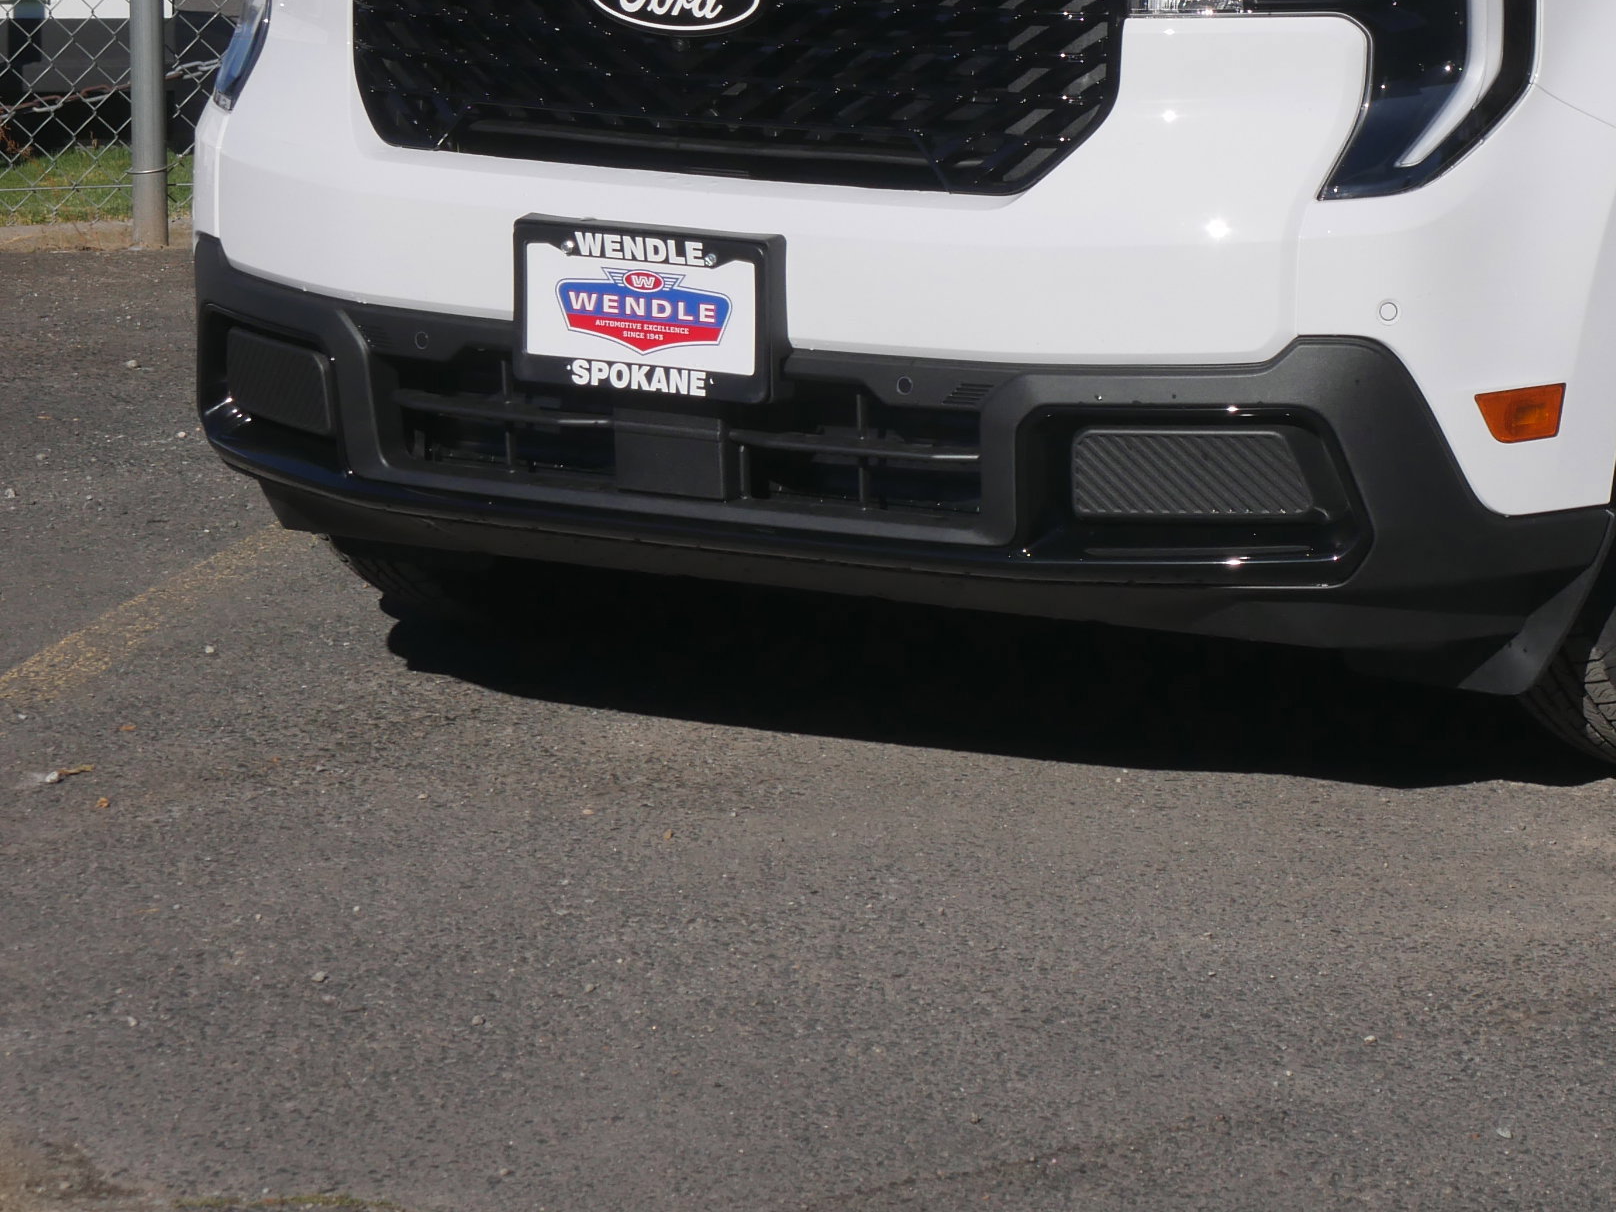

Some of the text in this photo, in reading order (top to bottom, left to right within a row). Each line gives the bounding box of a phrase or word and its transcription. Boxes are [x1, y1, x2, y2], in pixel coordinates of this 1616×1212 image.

[574, 231, 705, 267] WENDLE
[568, 291, 716, 323] WENDLE
[595, 319, 690, 335] AUTOMOTIVE EXCELLENCE
[622, 330, 664, 341] SINCE 1943
[571, 359, 707, 397] SPOKANE
